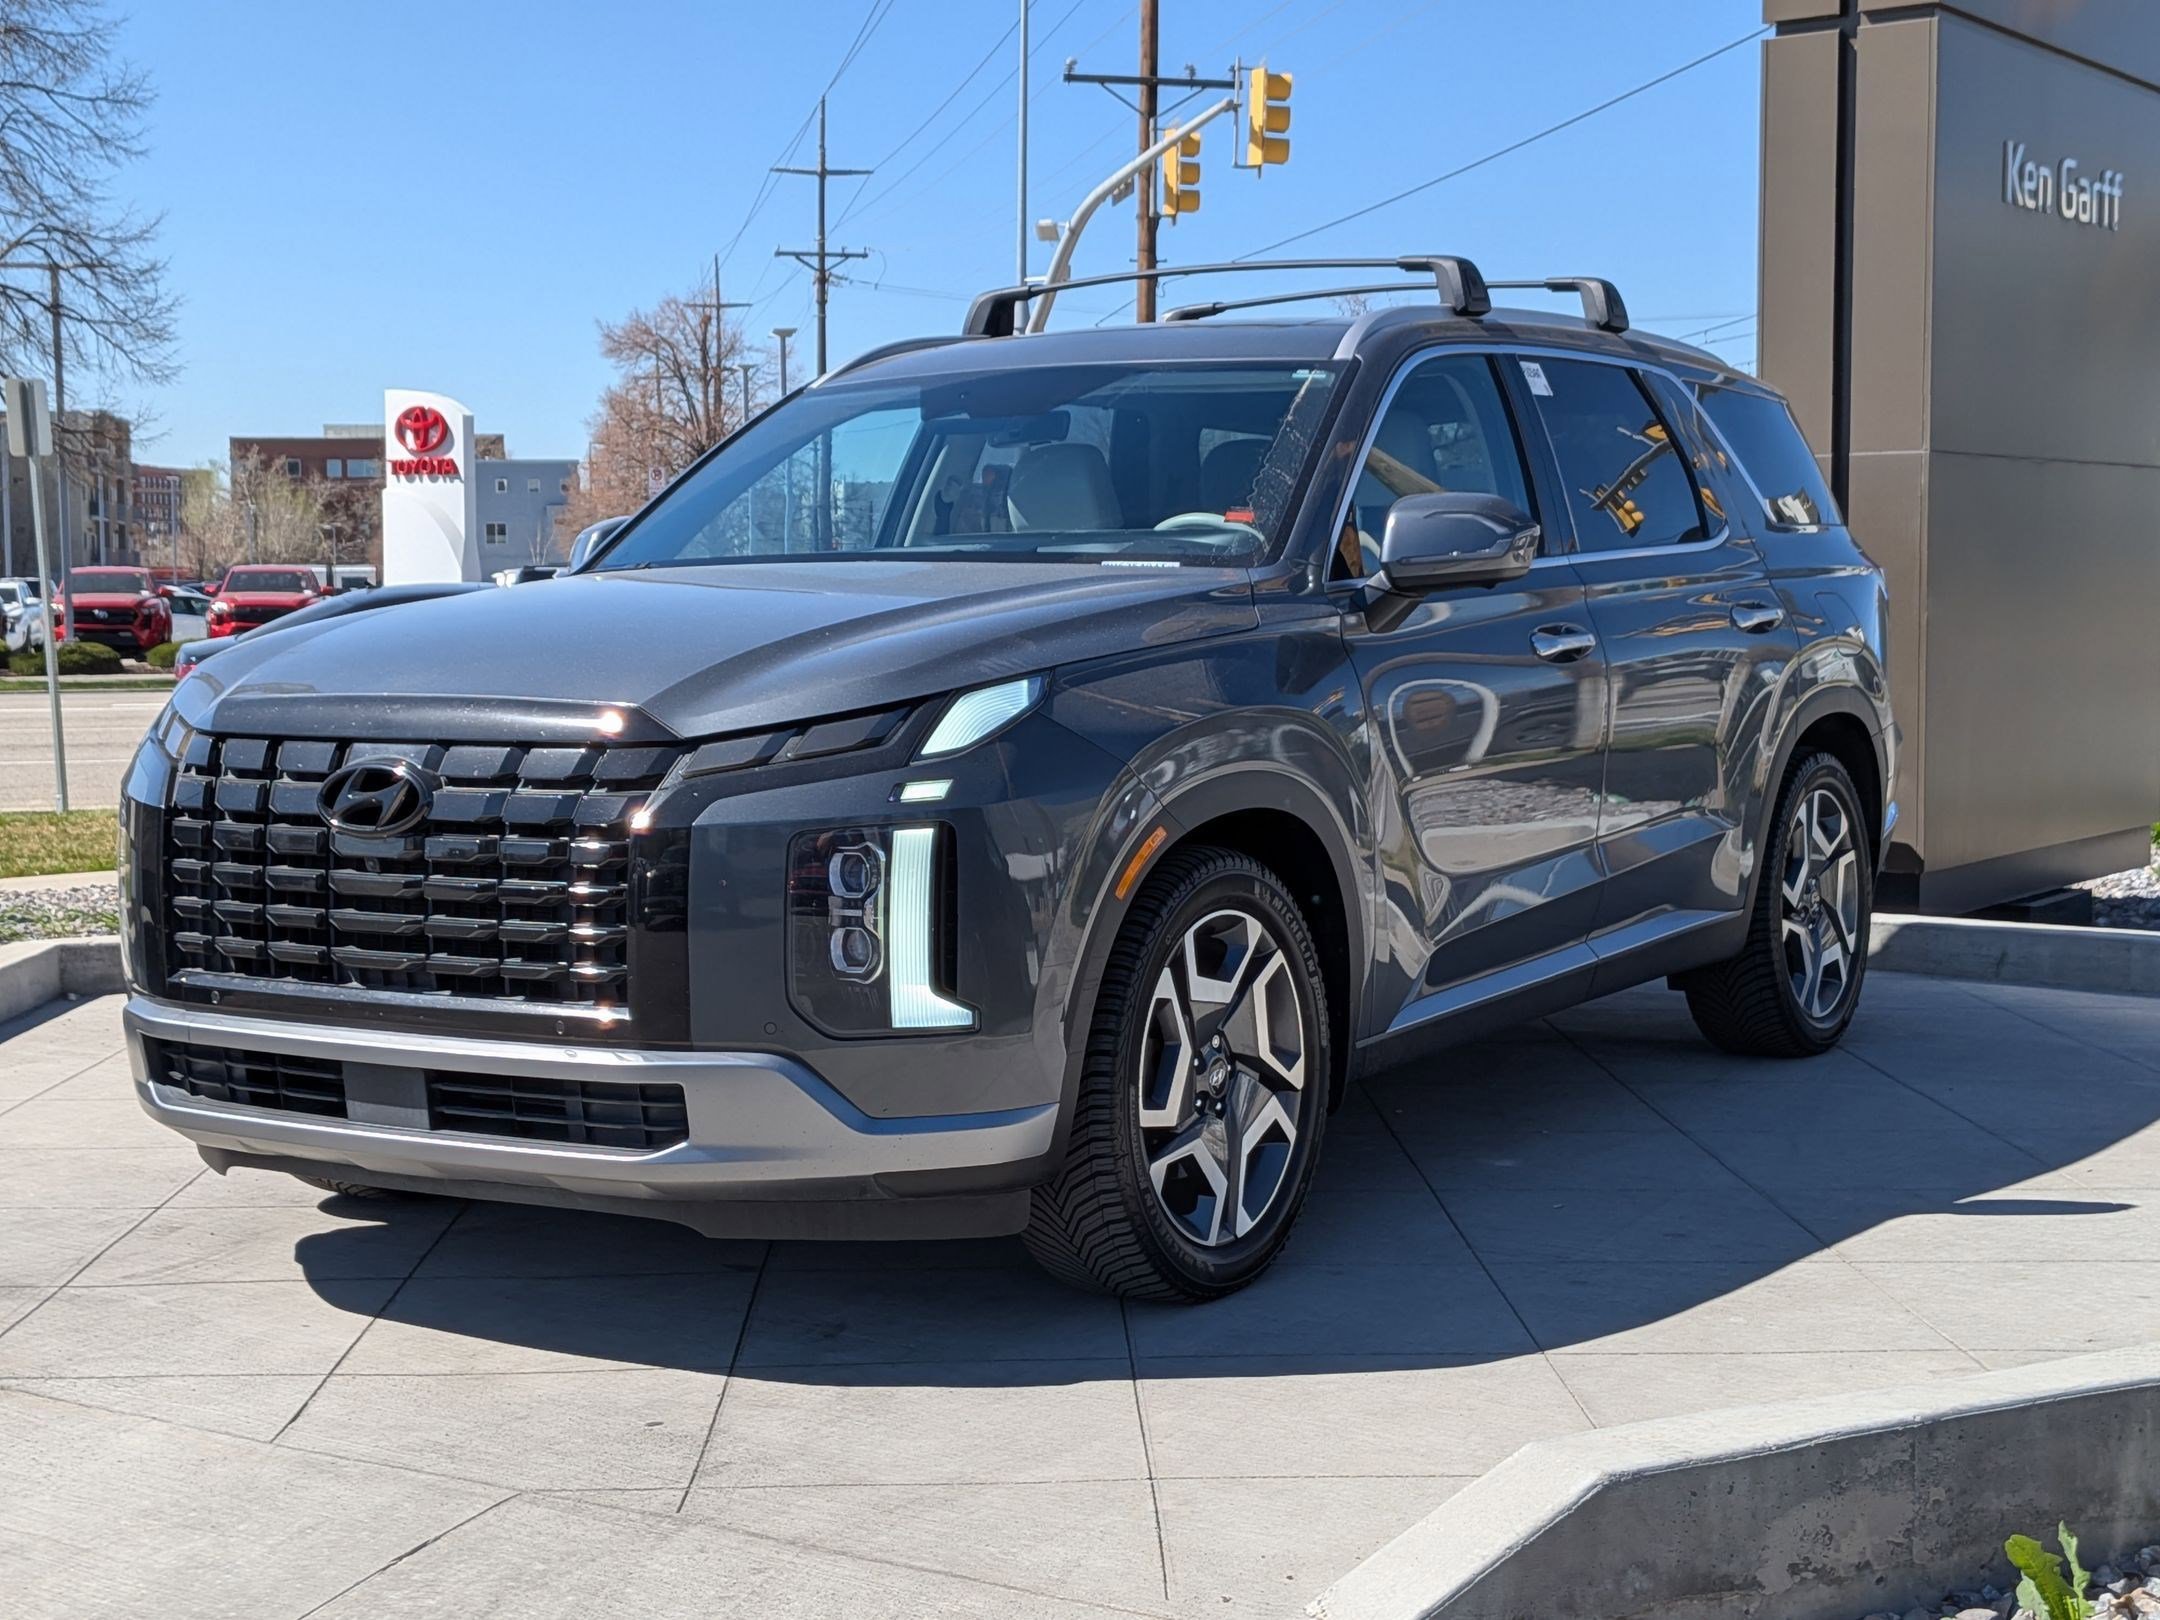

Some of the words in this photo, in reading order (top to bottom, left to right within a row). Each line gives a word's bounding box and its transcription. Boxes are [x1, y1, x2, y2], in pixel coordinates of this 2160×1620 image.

[2003, 139, 2052, 214] Ken
[2058, 158, 2123, 231] Garff
[388, 457, 459, 475] TOYOTA
[1272, 893, 1316, 973] MICHELIN
